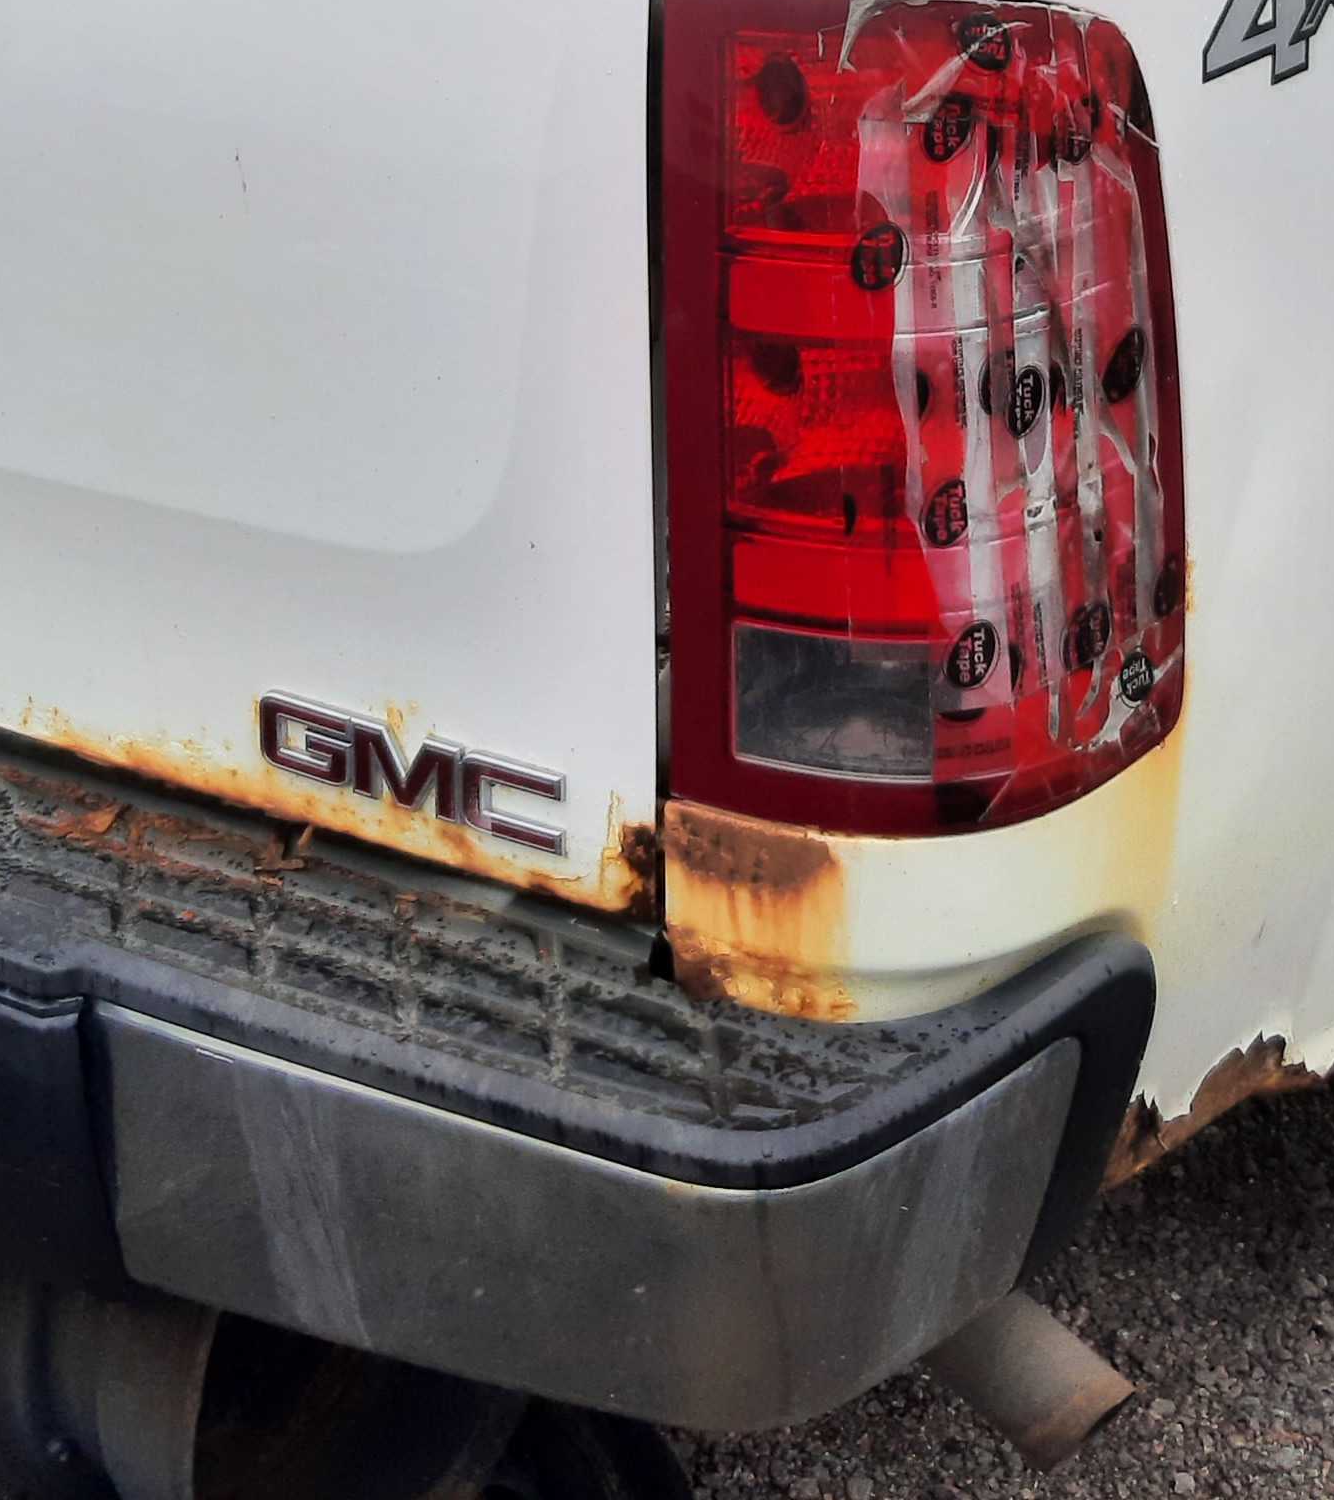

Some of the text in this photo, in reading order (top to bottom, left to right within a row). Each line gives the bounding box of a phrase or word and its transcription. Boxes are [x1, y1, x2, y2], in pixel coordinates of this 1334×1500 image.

[1020, 374, 1036, 422] Tuck
[948, 484, 964, 534] Tuck
[957, 636, 972, 684] Tape
[971, 626, 986, 678] Tuck
[1122, 657, 1147, 679] Tape
[1126, 672, 1152, 696] Tuck
[258, 689, 567, 857] GMC
